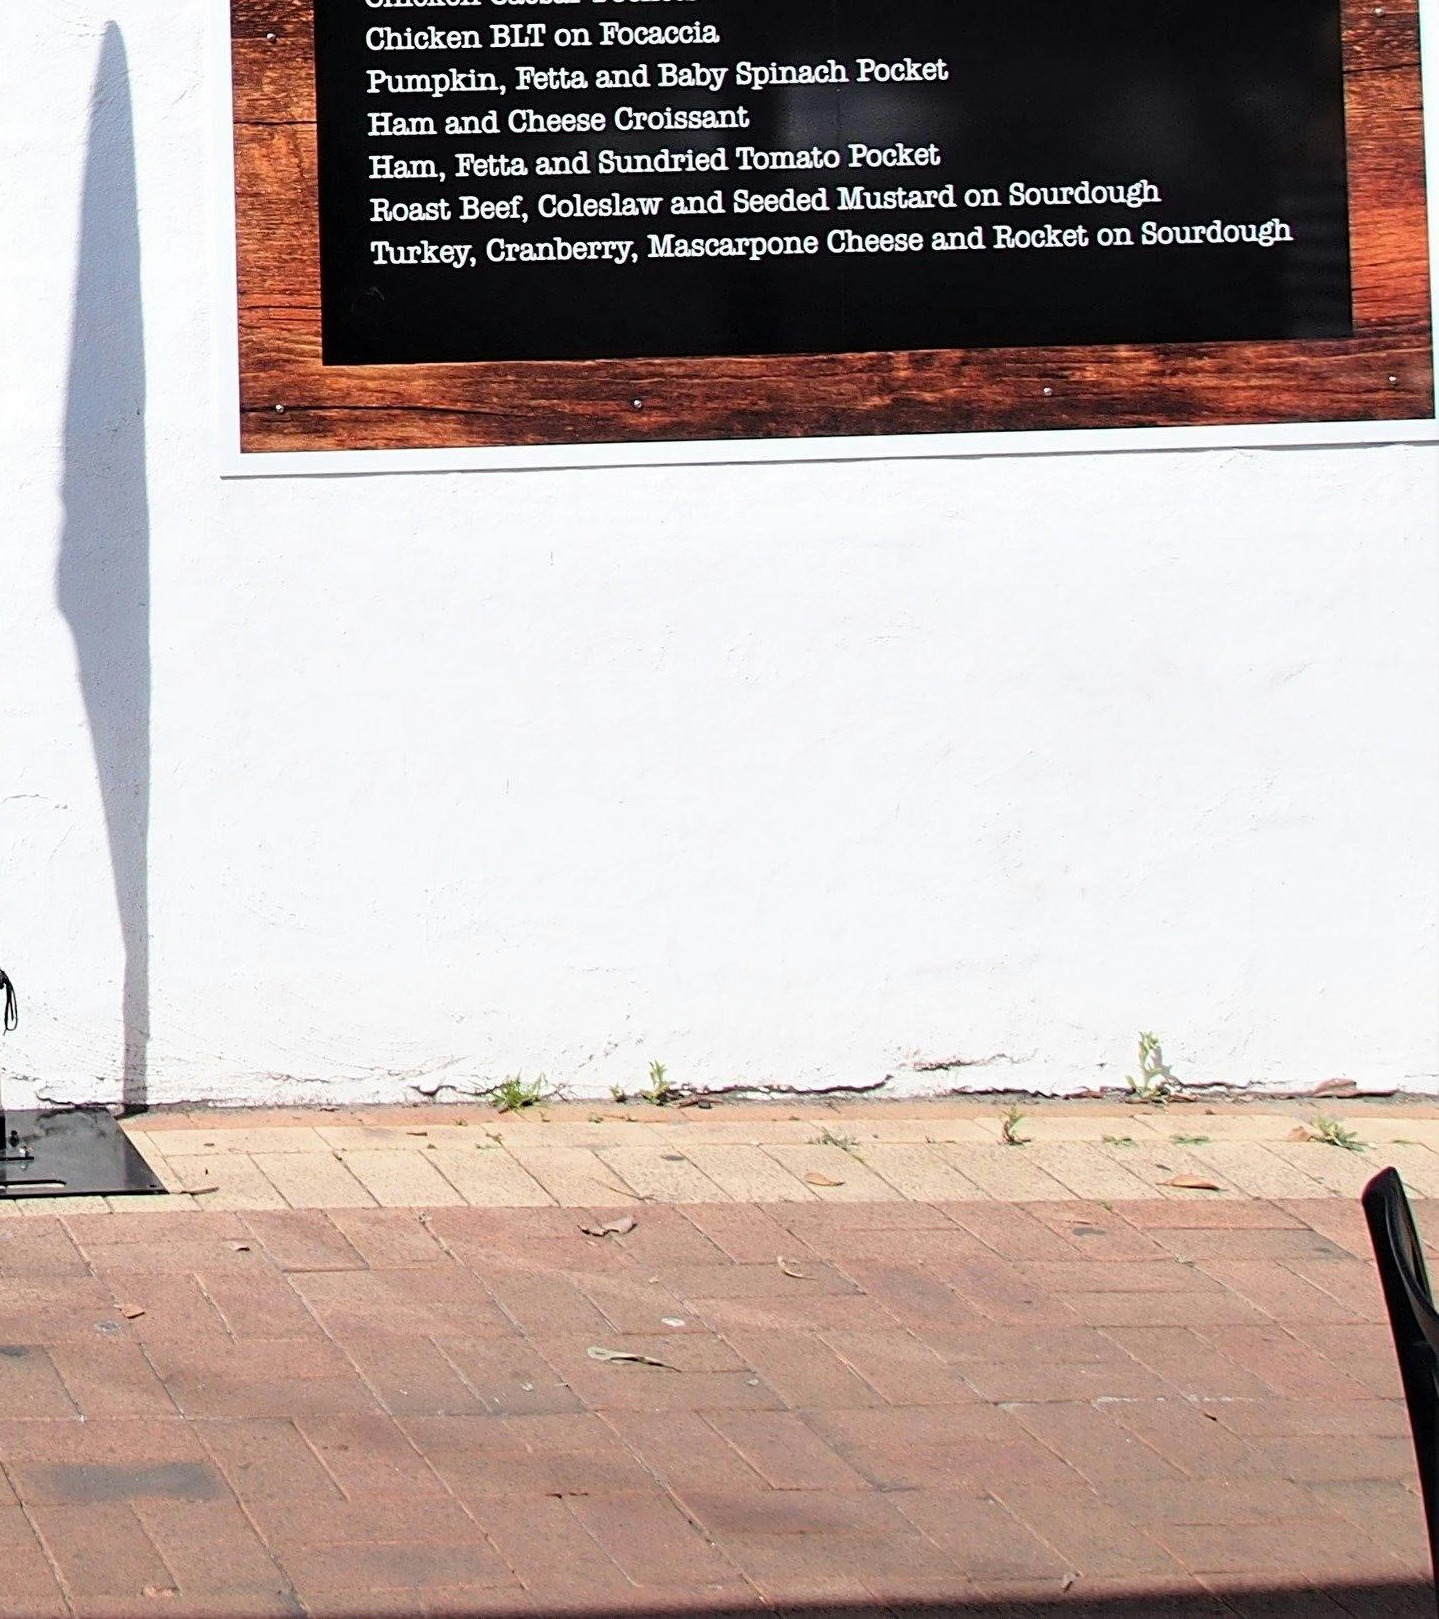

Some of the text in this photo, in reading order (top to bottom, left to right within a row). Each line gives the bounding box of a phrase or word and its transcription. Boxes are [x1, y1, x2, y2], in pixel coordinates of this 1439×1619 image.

[365, 20, 720, 51] Chicken BLT on Focaccia
[365, 57, 949, 98] Pumpkin, Fetta and Baby Spinach Pocket
[367, 105, 750, 137] Ham and Cheese Croissant
[368, 142, 941, 183] Ham, Fetta and Sundried Tomato Pocket
[369, 179, 1162, 224] Roast Beef, Coleslaw and Seeded Mustard on Sourdough
[370, 218, 1294, 269] Turkey, Cranberry, Mascarpone Cheese and Rocket on Sourdough
